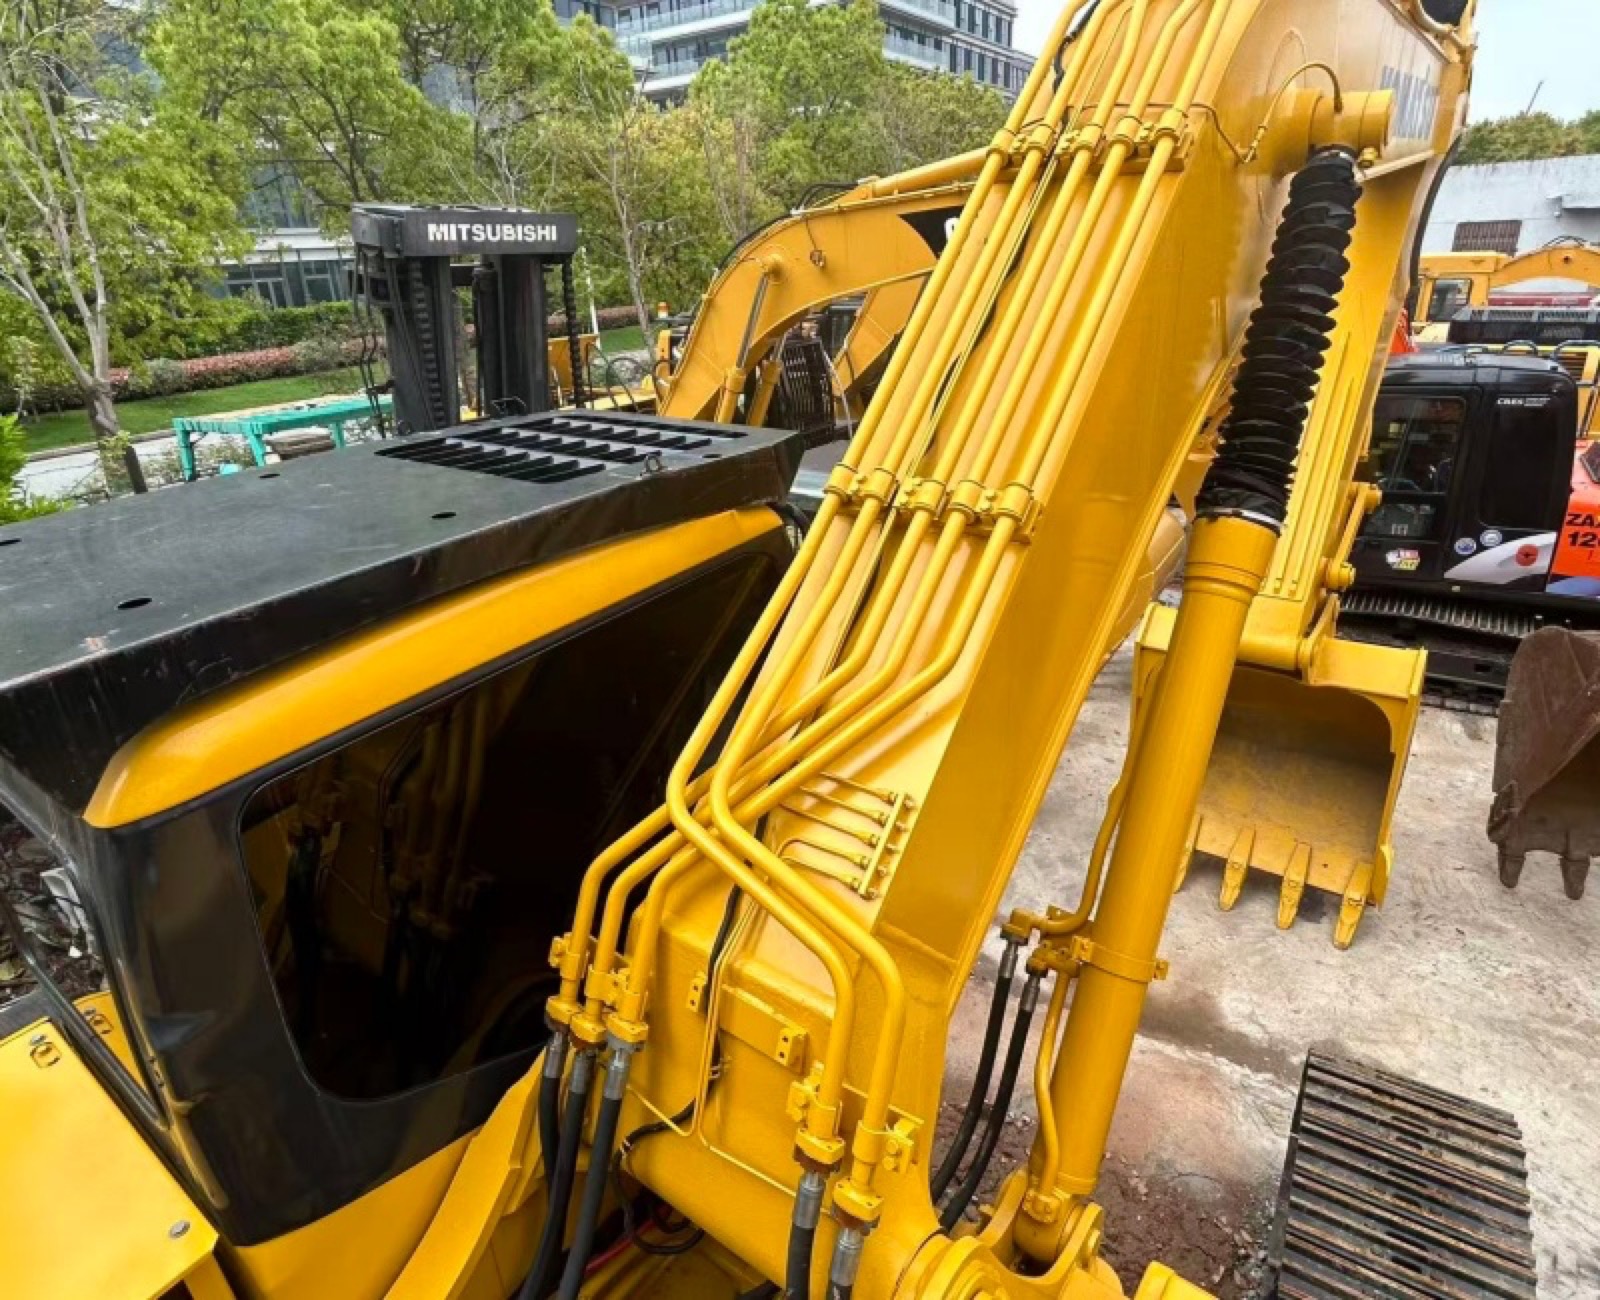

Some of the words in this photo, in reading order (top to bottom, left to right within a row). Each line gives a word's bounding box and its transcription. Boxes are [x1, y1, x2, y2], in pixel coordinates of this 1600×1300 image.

[428, 223, 557, 242] MITSUBISHI
[1565, 512, 1600, 528] ZA
[1568, 531, 1600, 548] 12
